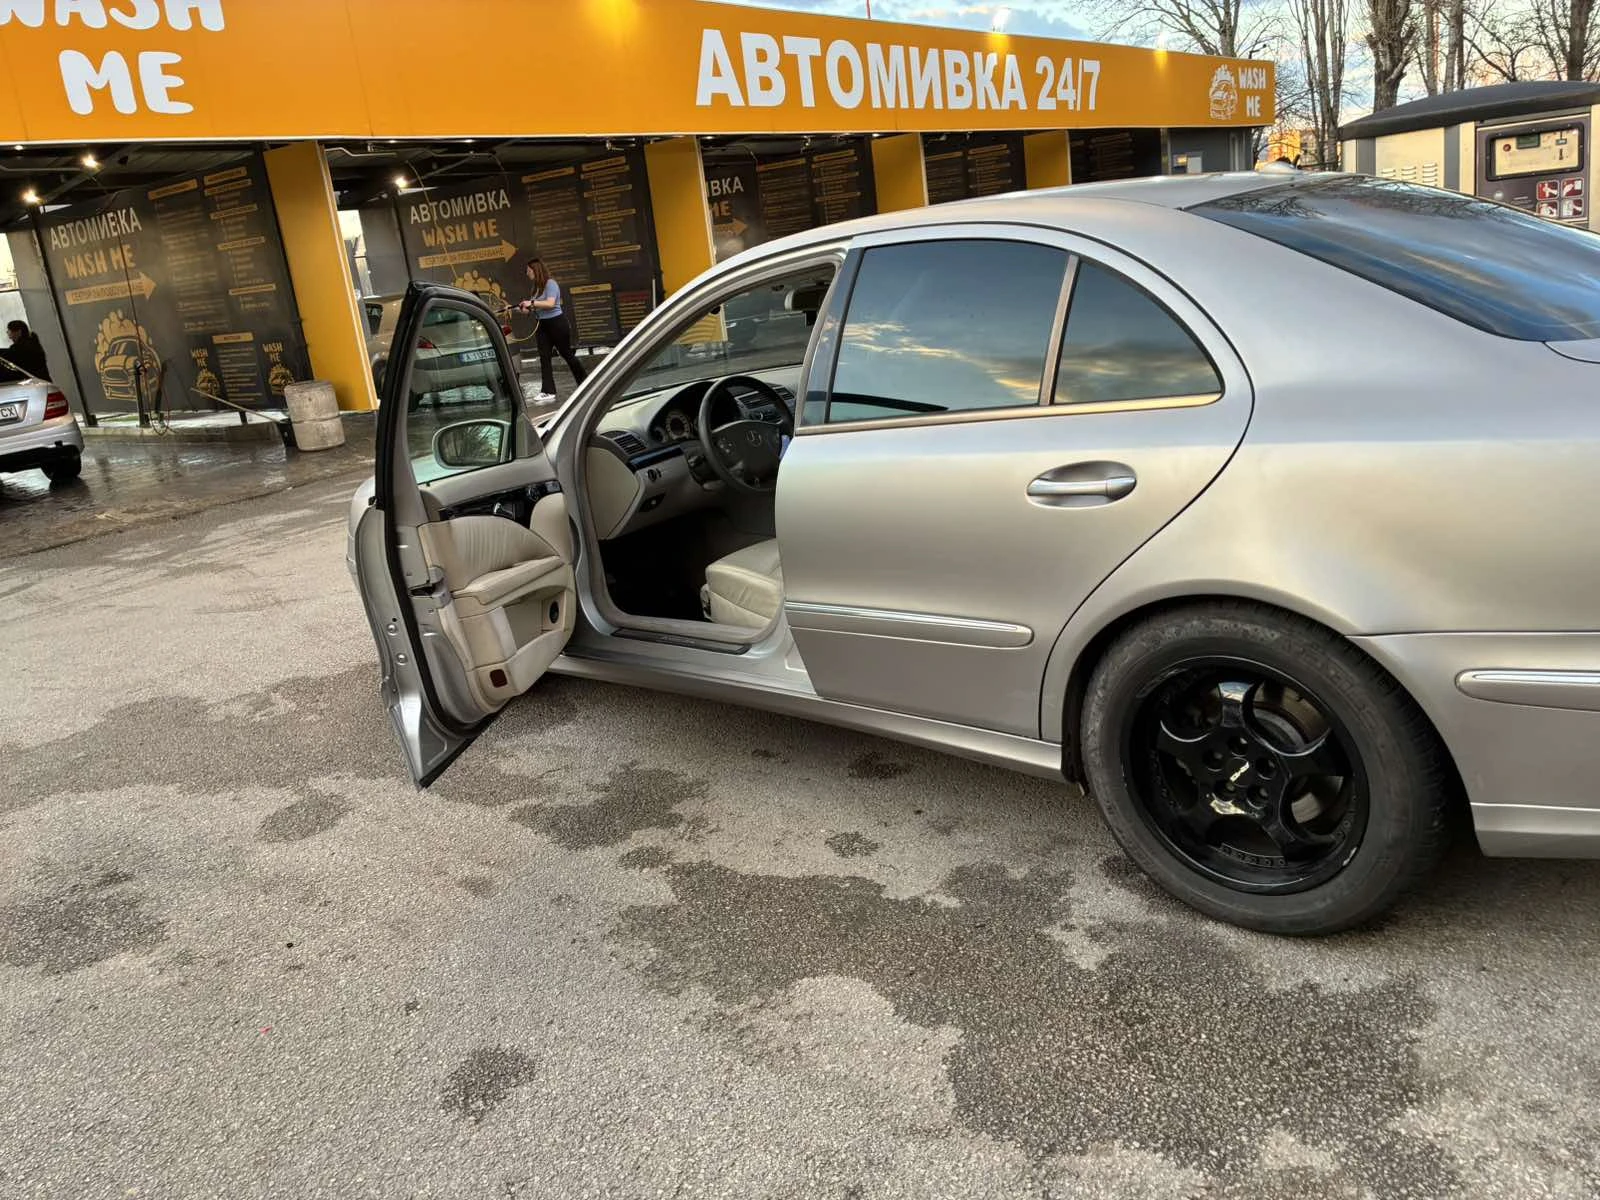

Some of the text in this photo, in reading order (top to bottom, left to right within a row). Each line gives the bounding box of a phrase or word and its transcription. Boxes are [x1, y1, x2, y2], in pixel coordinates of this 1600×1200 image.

[59, 50, 194, 115] ME
[696, 28, 1101, 111] АВТОМИВКА 24/7
[1238, 67, 1266, 90] WASH
[1246, 95, 1261, 117] ME
[410, 188, 511, 225] АВТОМИВКА
[422, 218, 499, 248] WASH ME
[64, 243, 136, 280] WASH ME
